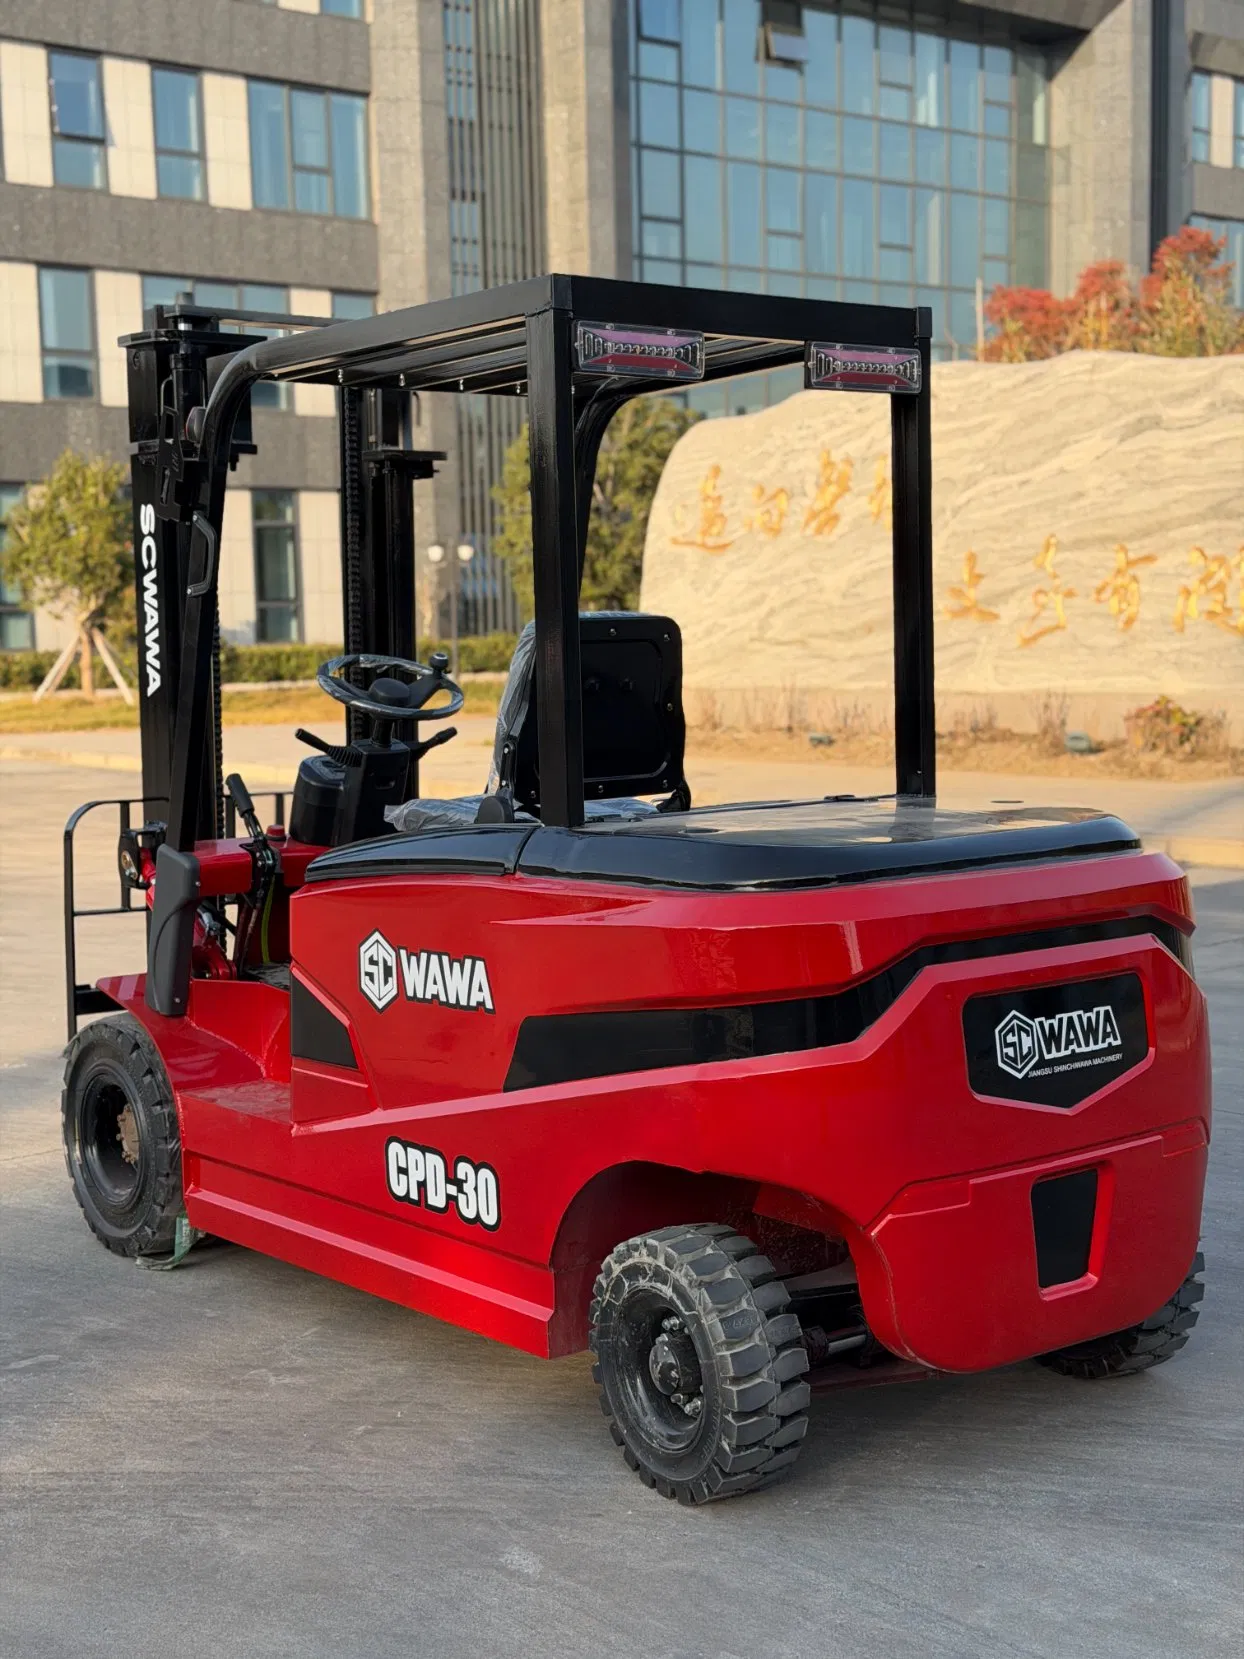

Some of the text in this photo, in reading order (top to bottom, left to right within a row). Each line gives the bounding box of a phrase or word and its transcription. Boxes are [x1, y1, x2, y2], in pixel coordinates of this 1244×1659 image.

[140, 504, 161, 697] SCWAWA
[398, 947, 495, 1012] WAWA
[1034, 1006, 1122, 1059] WAWA
[1028, 1066, 1053, 1078] JIANGSU
[1092, 1053, 1123, 1066] MACHINERY
[387, 1140, 499, 1227] CPD-30
